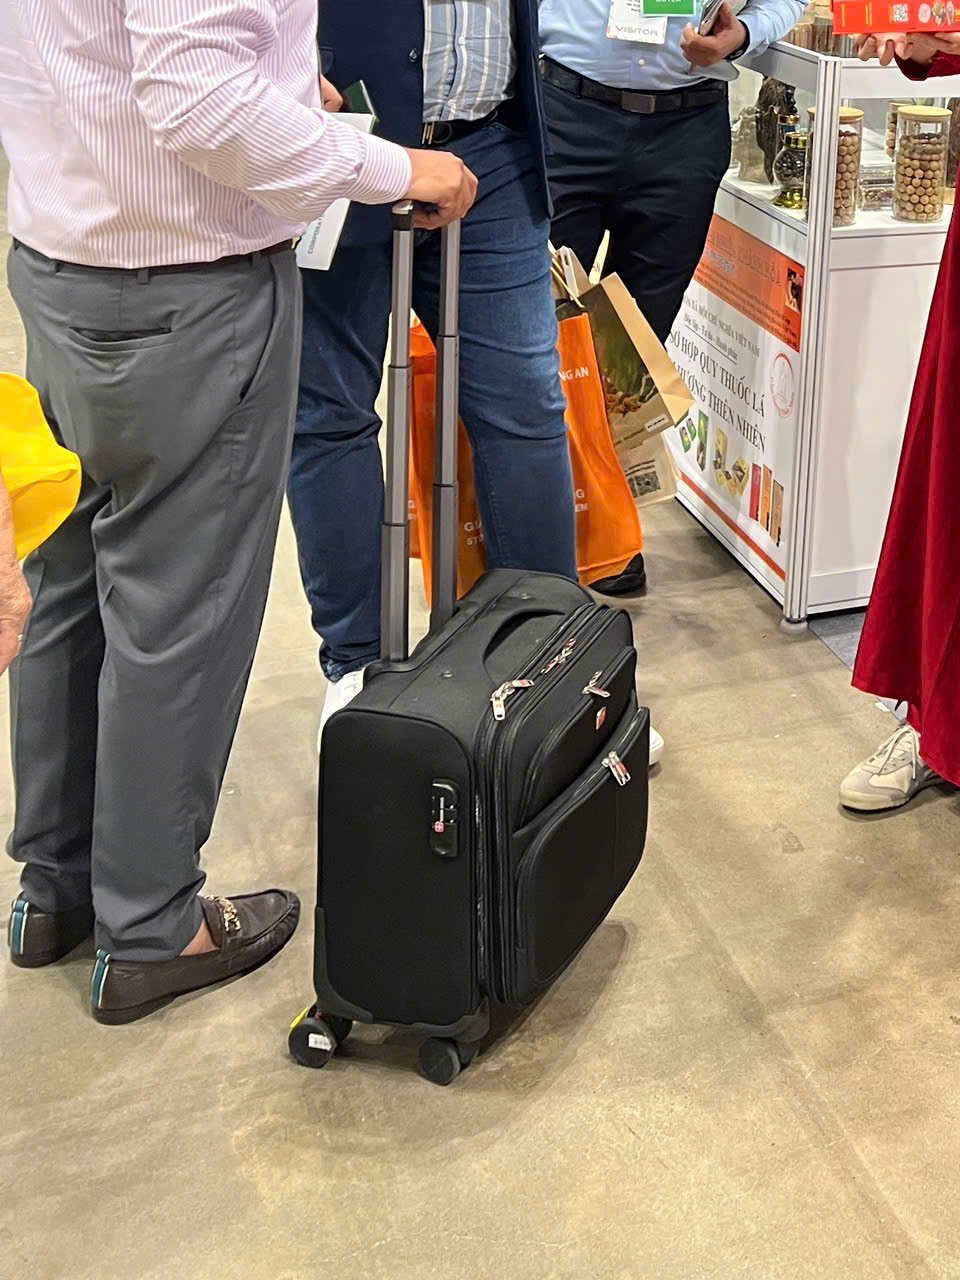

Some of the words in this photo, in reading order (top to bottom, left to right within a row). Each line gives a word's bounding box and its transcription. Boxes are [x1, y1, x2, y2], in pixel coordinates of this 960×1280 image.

[615, 24, 659, 37] VISITOR
[699, 351, 719, 380] QUY
[719, 364, 752, 406] THUỐC
[752, 392, 765, 419] LÁ
[708, 389, 736, 427] THIÊN
[736, 413, 767, 454] NHIÊN
